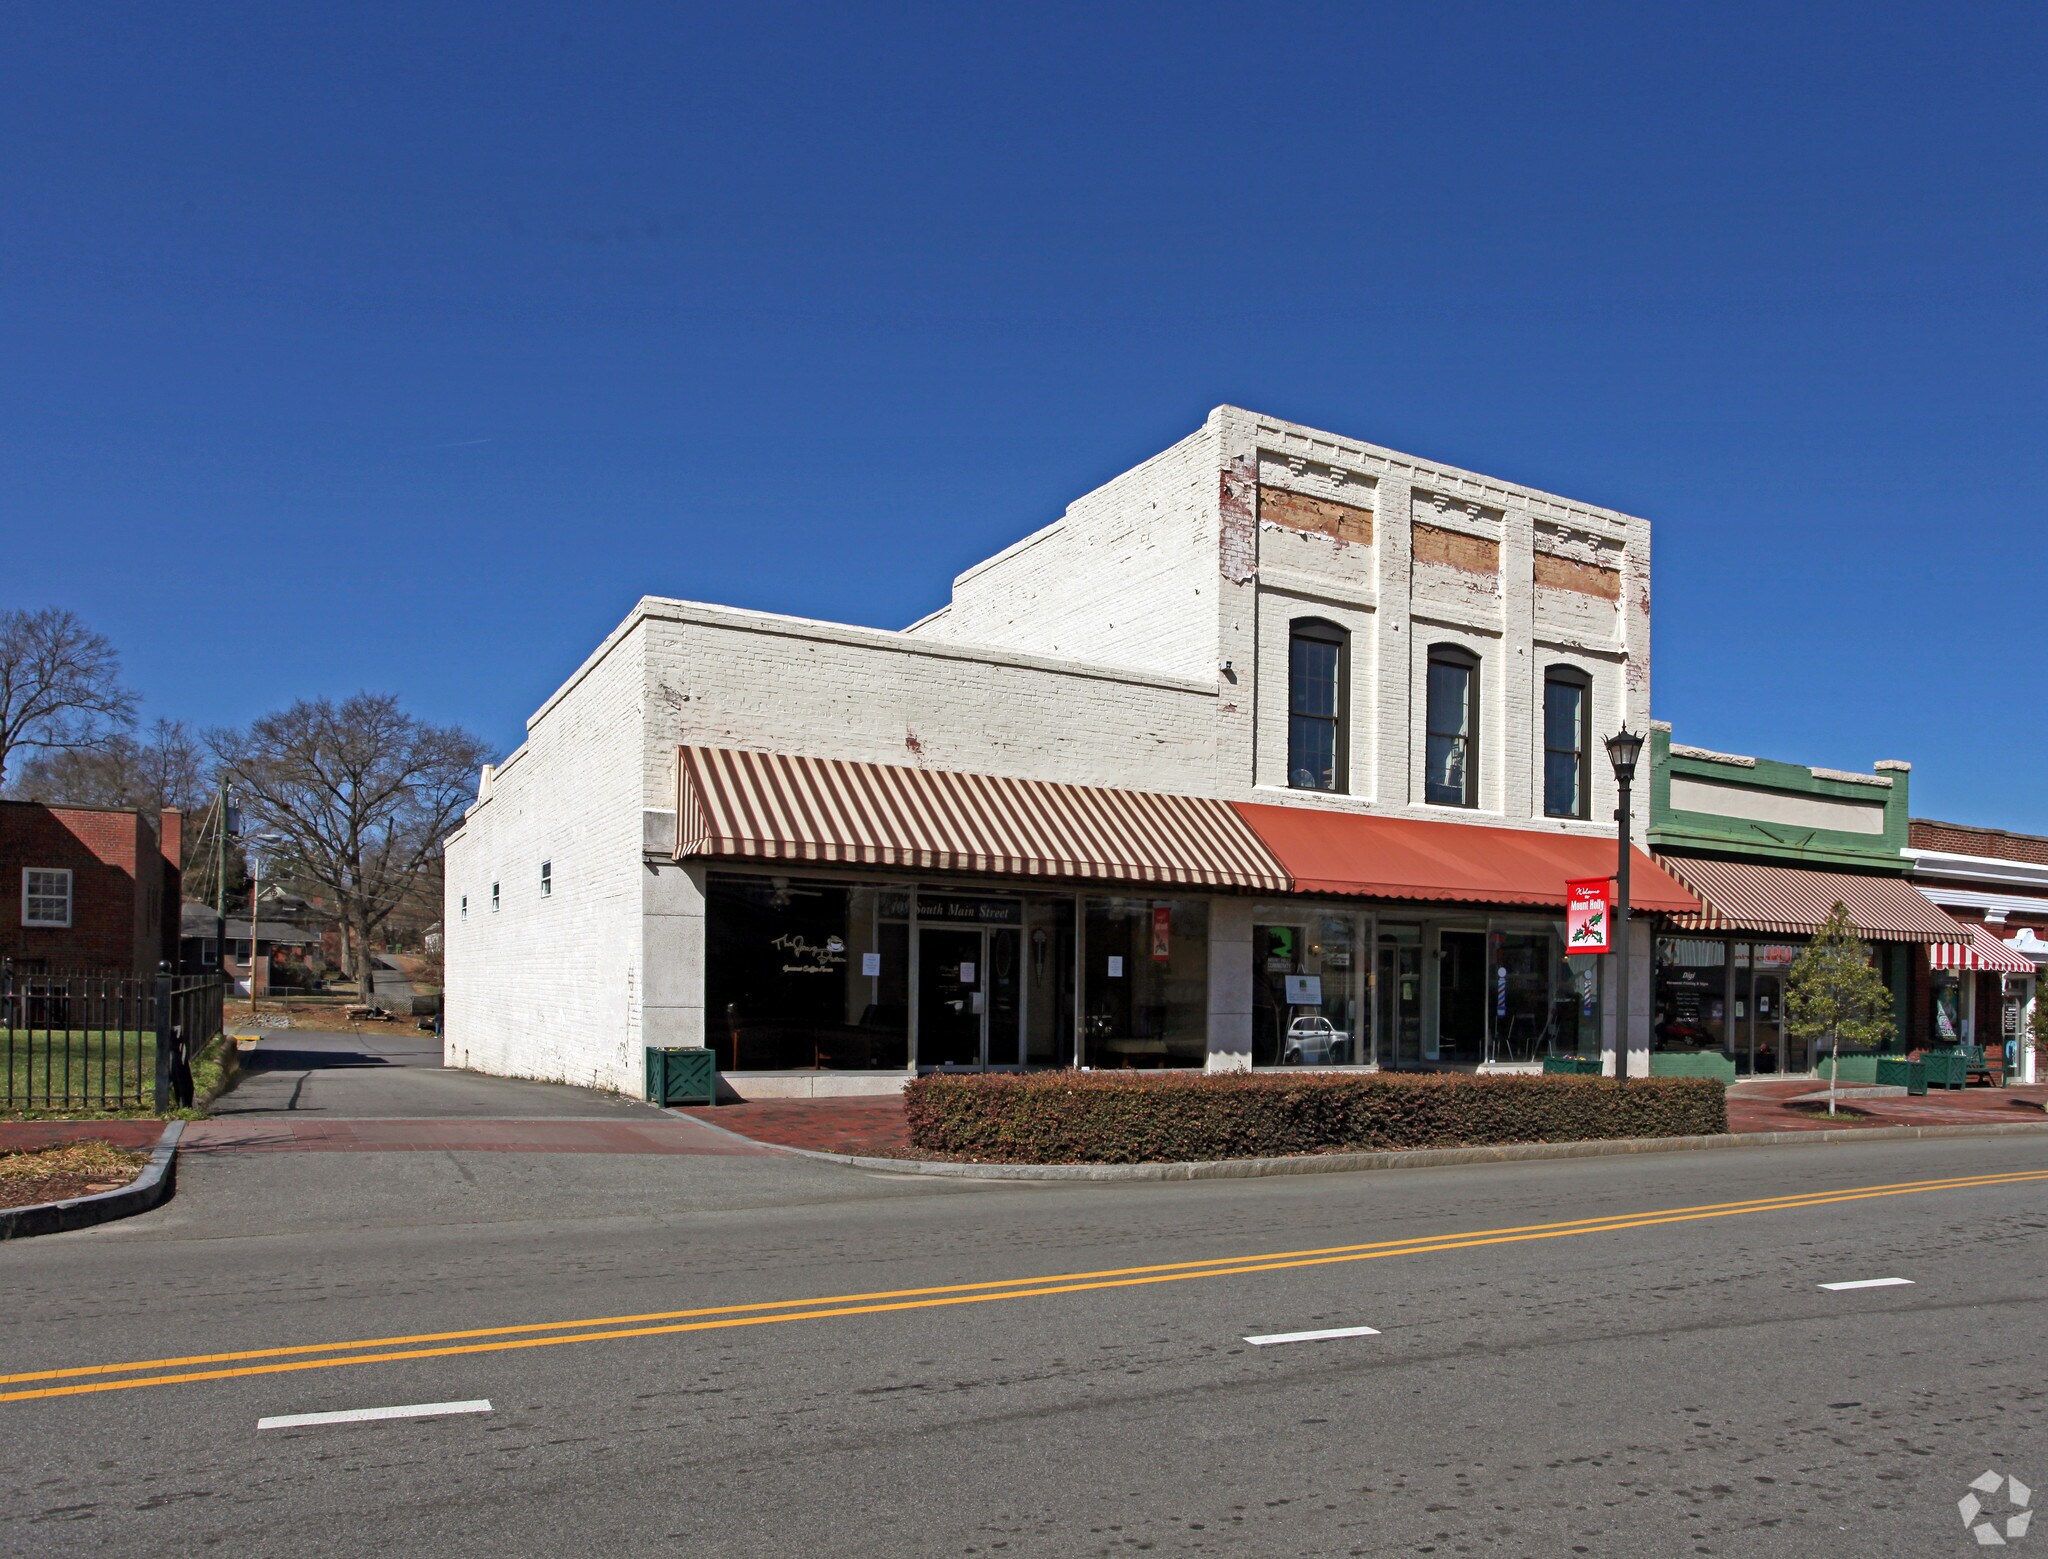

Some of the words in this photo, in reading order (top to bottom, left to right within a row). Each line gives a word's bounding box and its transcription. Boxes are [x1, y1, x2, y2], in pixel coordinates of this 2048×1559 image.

[1576, 887, 1600, 895] Welcome
[916, 902, 943, 916] South
[947, 903, 975, 917] Main
[978, 904, 1009, 918] Street
[1571, 900, 1589, 910] Mount
[1590, 899, 1604, 911] Holly
[1764, 946, 1792, 962] OPEN
